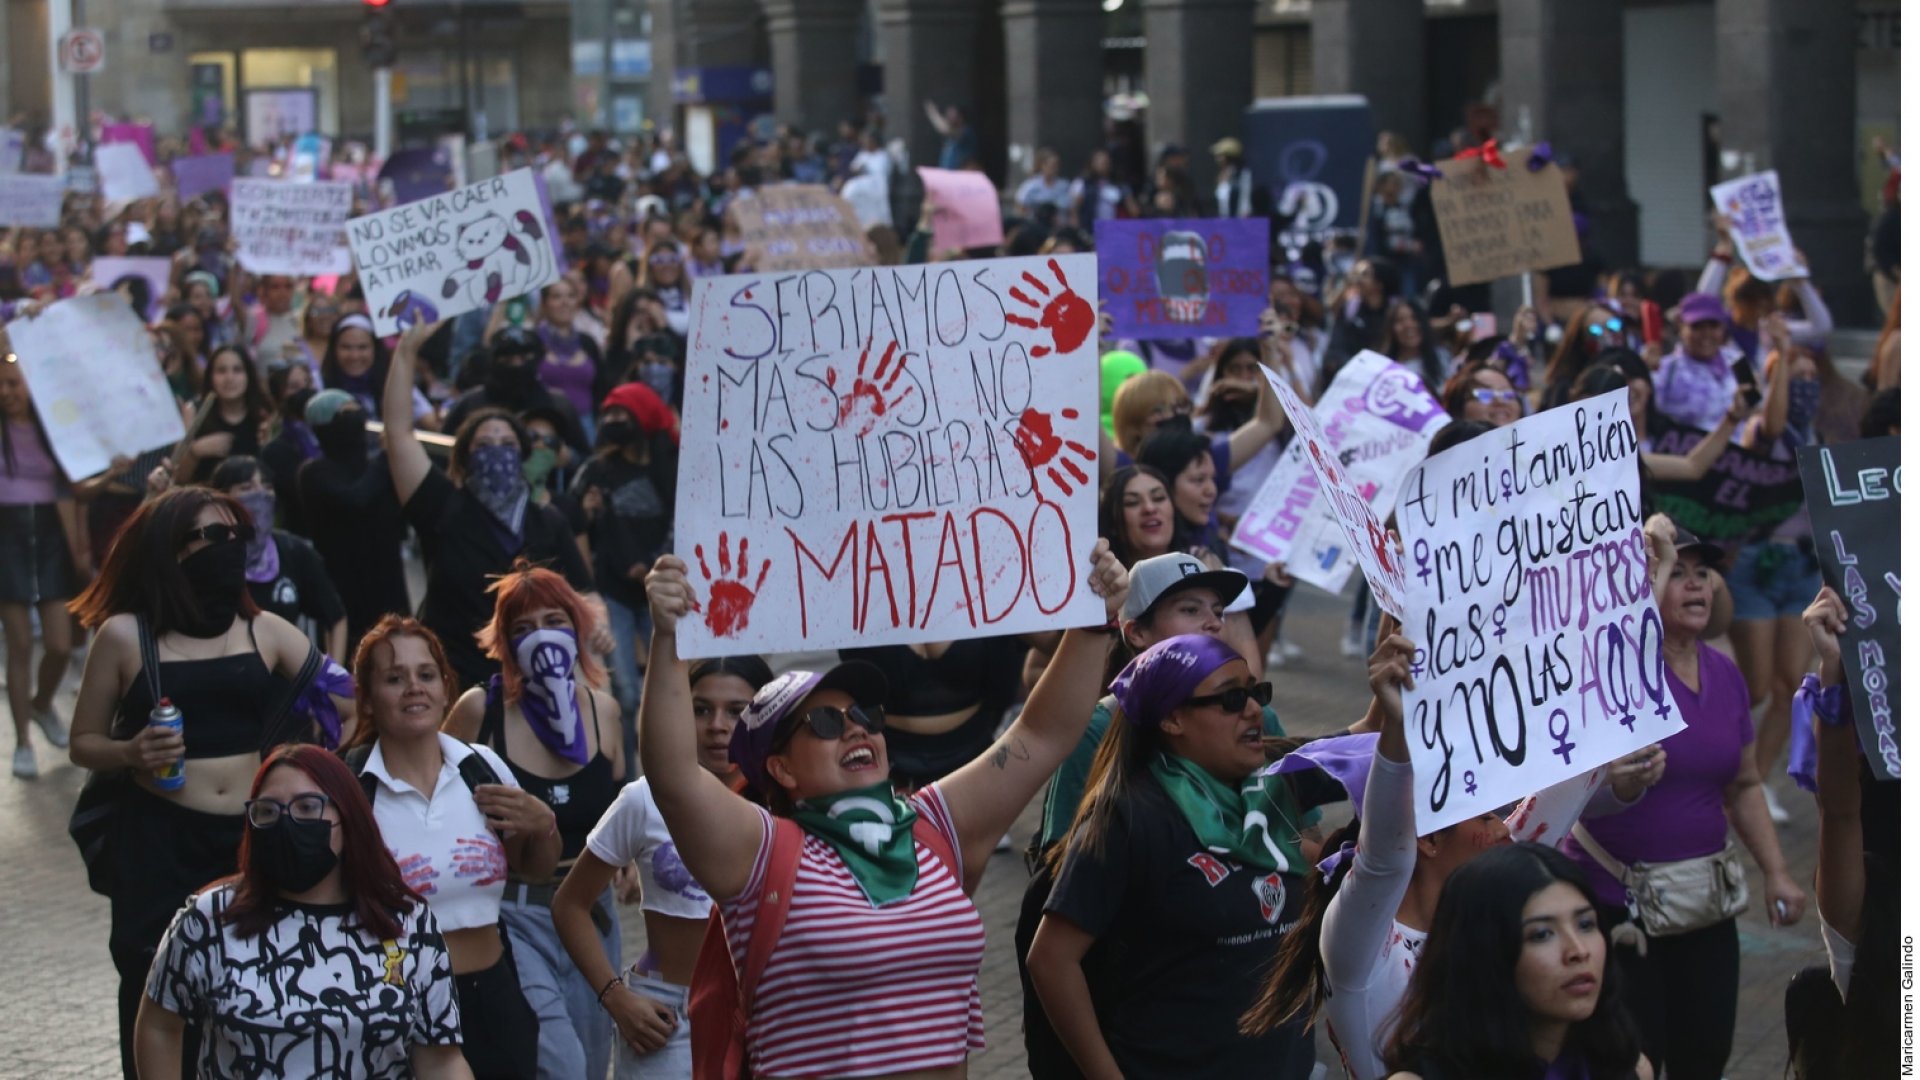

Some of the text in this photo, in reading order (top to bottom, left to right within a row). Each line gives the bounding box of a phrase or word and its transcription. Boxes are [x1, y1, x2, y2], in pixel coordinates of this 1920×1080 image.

[354, 218, 384, 245] NO
[389, 208, 417, 234] SE
[418, 198, 449, 220] VA
[452, 178, 509, 213] CAER
[724, 267, 1007, 360] SERÍAMOS
[717, 340, 1033, 435] MÁS SI NO
[717, 417, 1036, 519] LAS HUBIERAS
[1404, 467, 1438, 535] A
[1452, 456, 1498, 518] mi
[1506, 402, 1639, 496] también
[784, 500, 1076, 639] MATADO
[1434, 533, 1493, 604] me
[1496, 480, 1641, 608] gustan
[1425, 603, 1486, 680] las
[1525, 632, 1574, 707] LAS
[1578, 606, 1668, 730] ACOSO
[1830, 529, 1901, 779] LAS MORRAS
